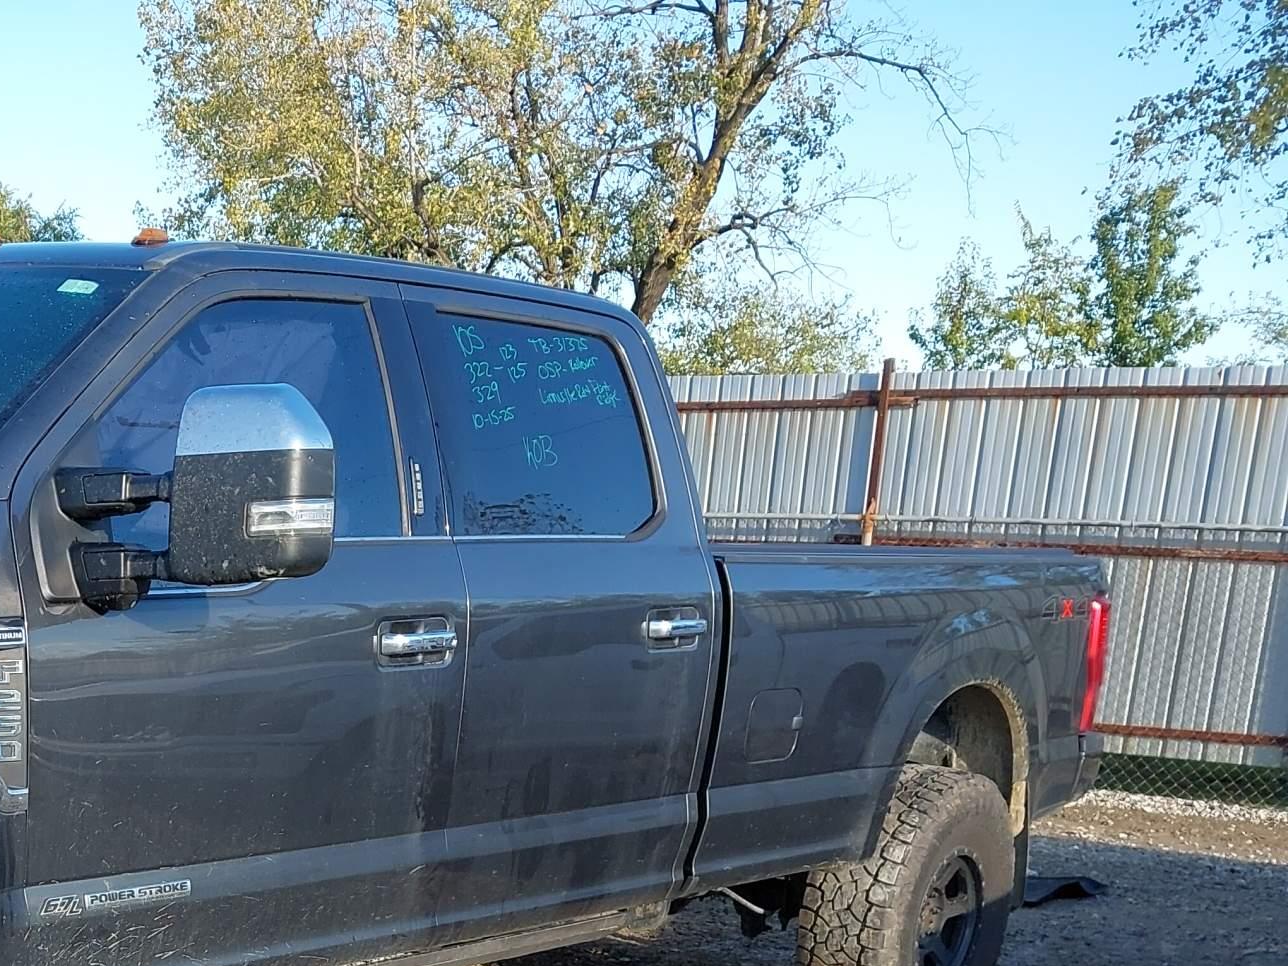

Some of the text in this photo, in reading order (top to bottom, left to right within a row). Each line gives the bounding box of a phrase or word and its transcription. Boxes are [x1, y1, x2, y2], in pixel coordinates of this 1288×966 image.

[472, 381, 502, 404] 329
[471, 406, 516, 430] 10-15-25
[89, 889, 136, 906] POWER
[137, 881, 190, 898] STROKE
